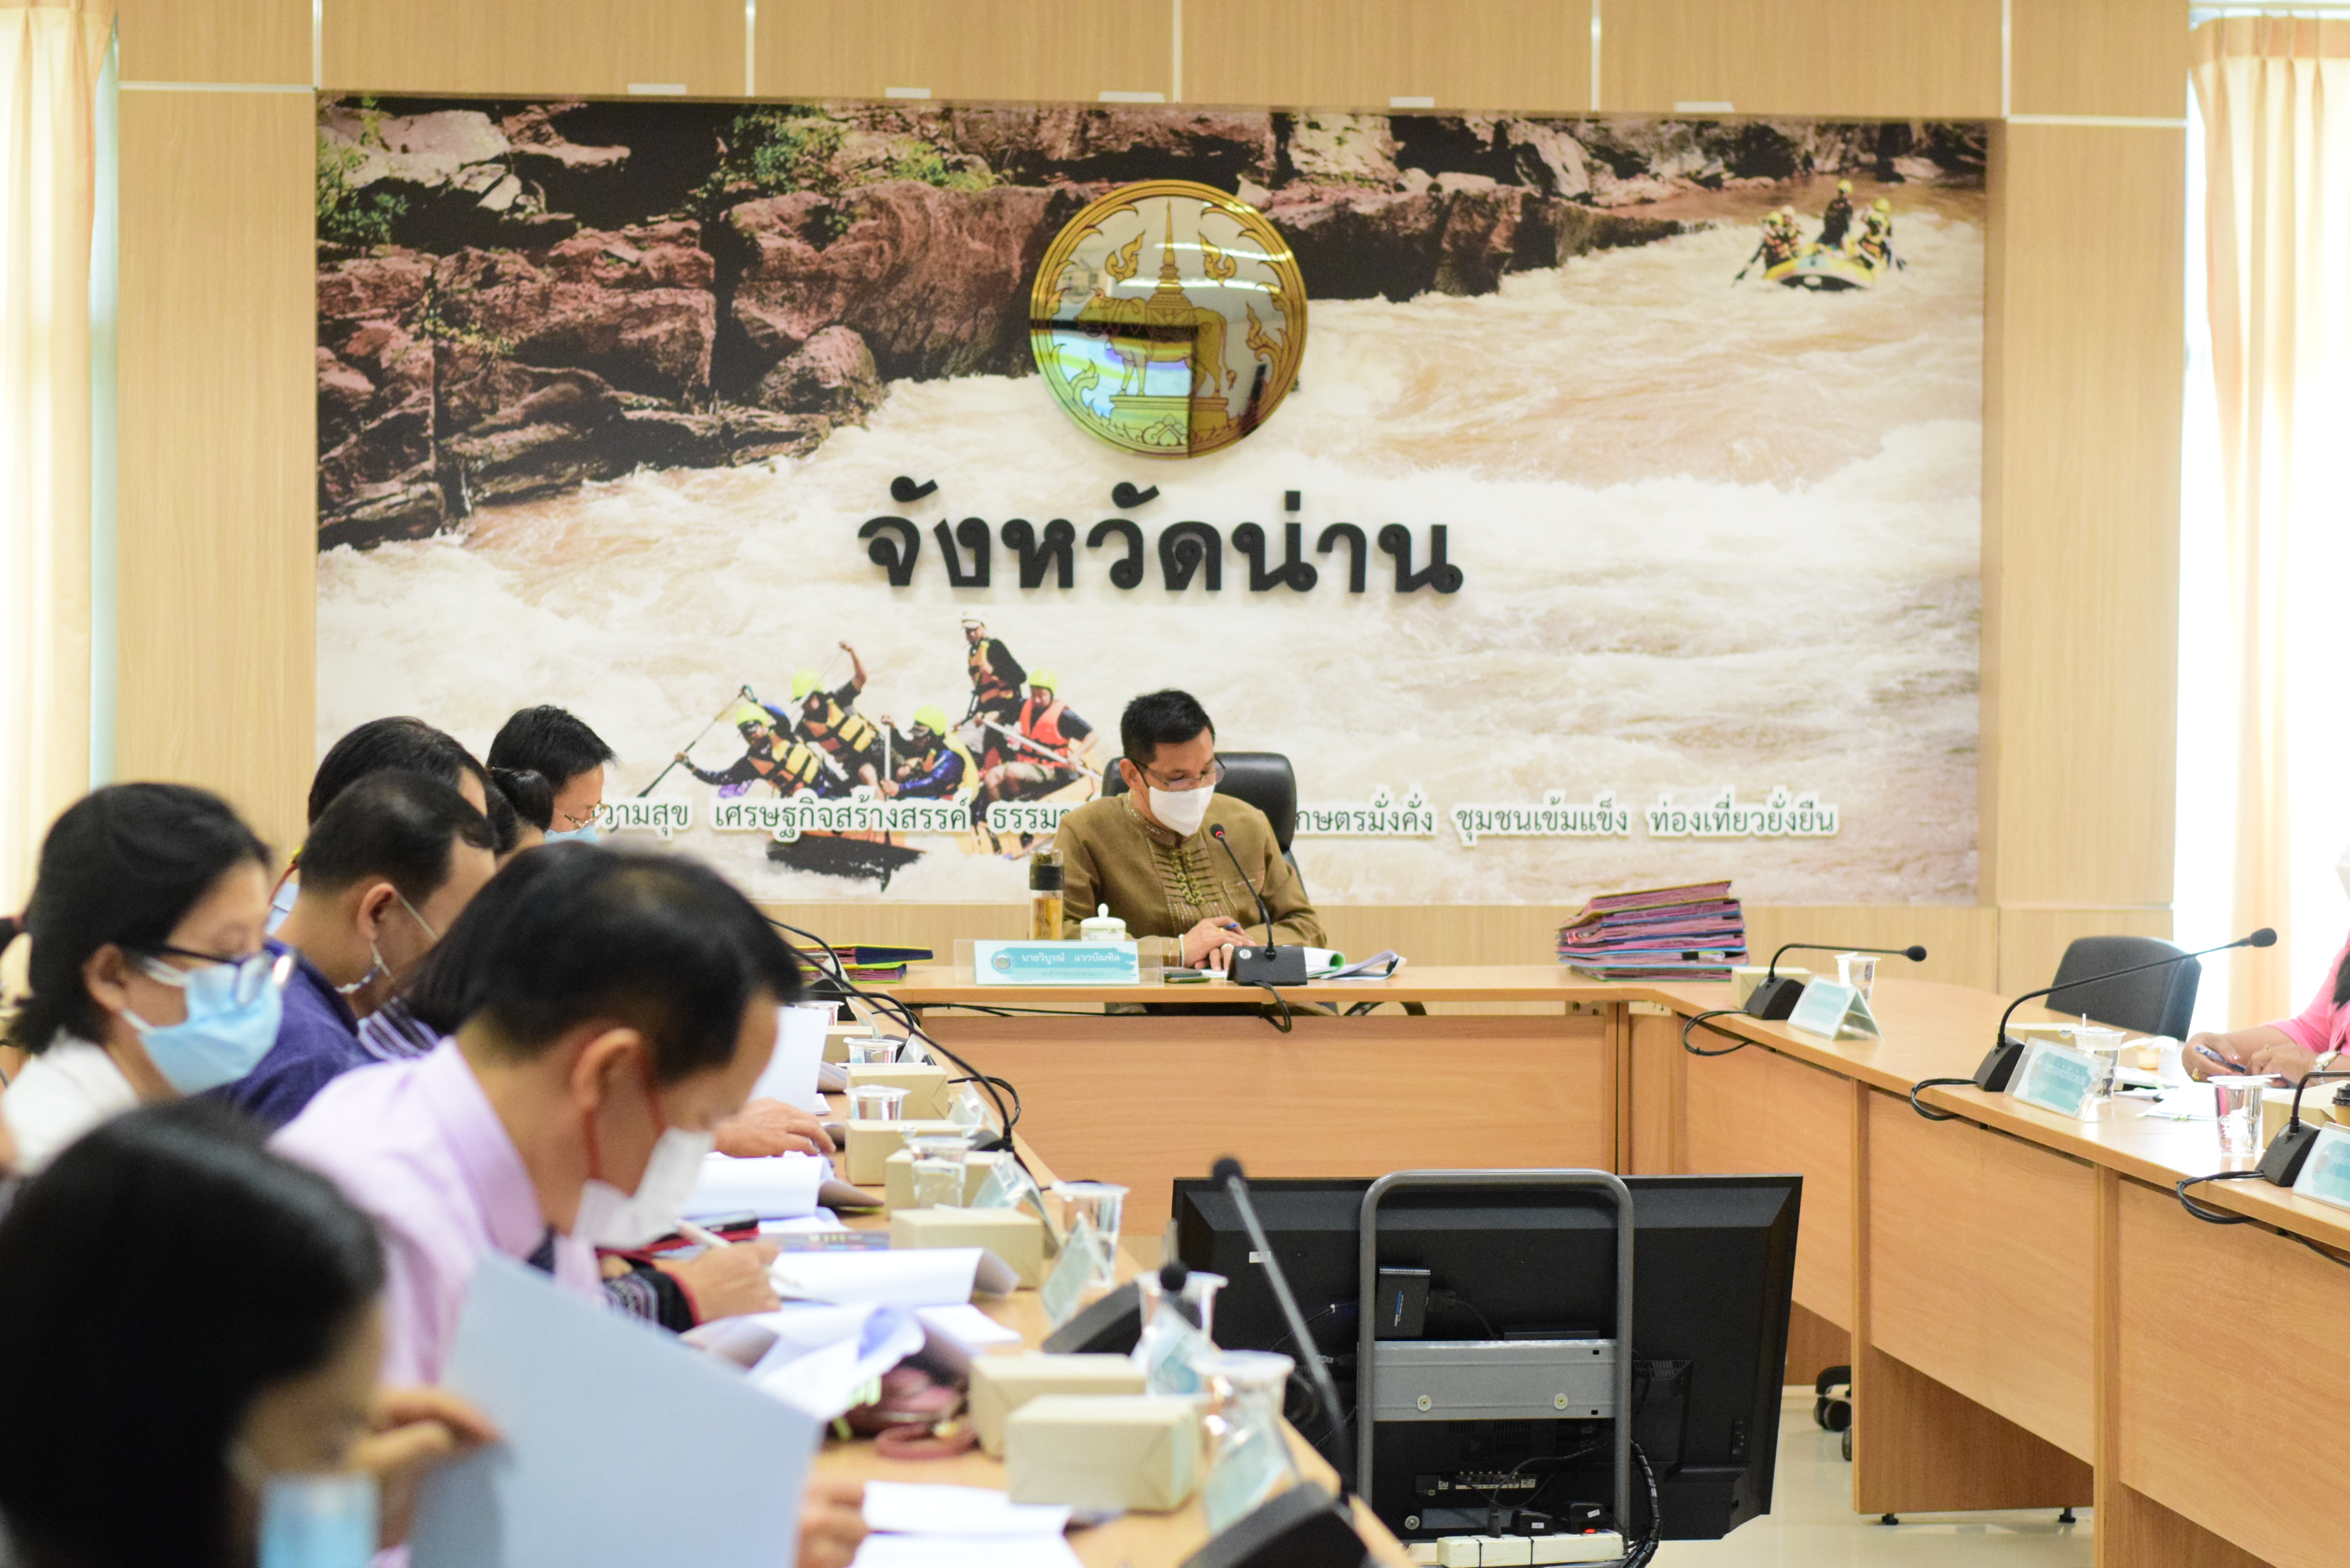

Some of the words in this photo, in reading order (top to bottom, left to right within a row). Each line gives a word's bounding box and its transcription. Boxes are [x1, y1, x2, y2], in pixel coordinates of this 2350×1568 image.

[858, 476, 1464, 594] จังหวัดน่าน
[716, 793, 970, 838] เศรษฐกิจสร้างสรรค์
[993, 808, 1070, 829] ธรรม
[1296, 792, 1432, 832] กษตรมั่งคั่ง
[1456, 796, 1627, 841] ชุมชนเข้มแข็ง
[1650, 793, 1834, 832] ท่องเที่ยวยั่งยืน
